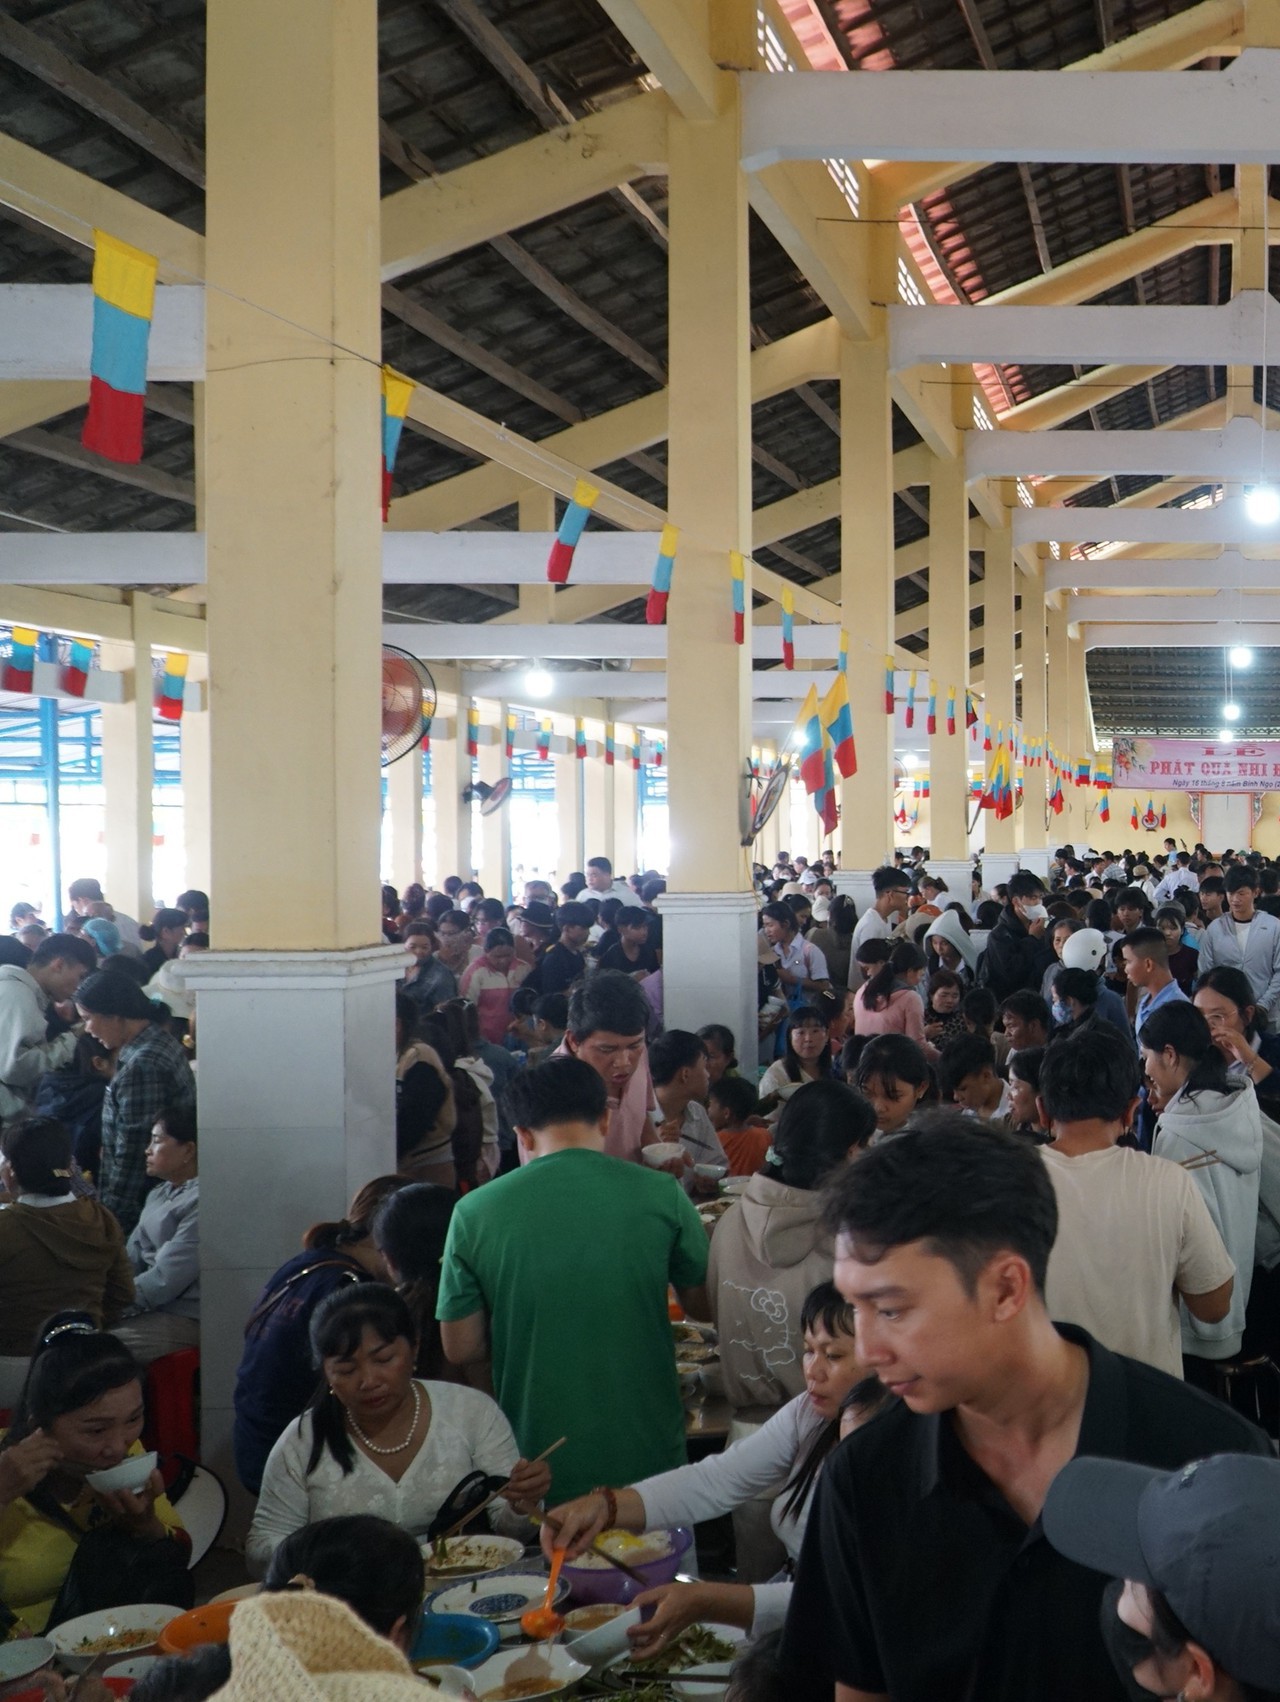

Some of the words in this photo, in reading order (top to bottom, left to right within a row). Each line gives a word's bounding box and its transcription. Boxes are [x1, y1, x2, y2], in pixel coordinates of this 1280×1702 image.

[1149, 759, 1195, 776] PHÁT
[1238, 762, 1268, 776] NHI
[1172, 779, 1190, 788] Ngày
